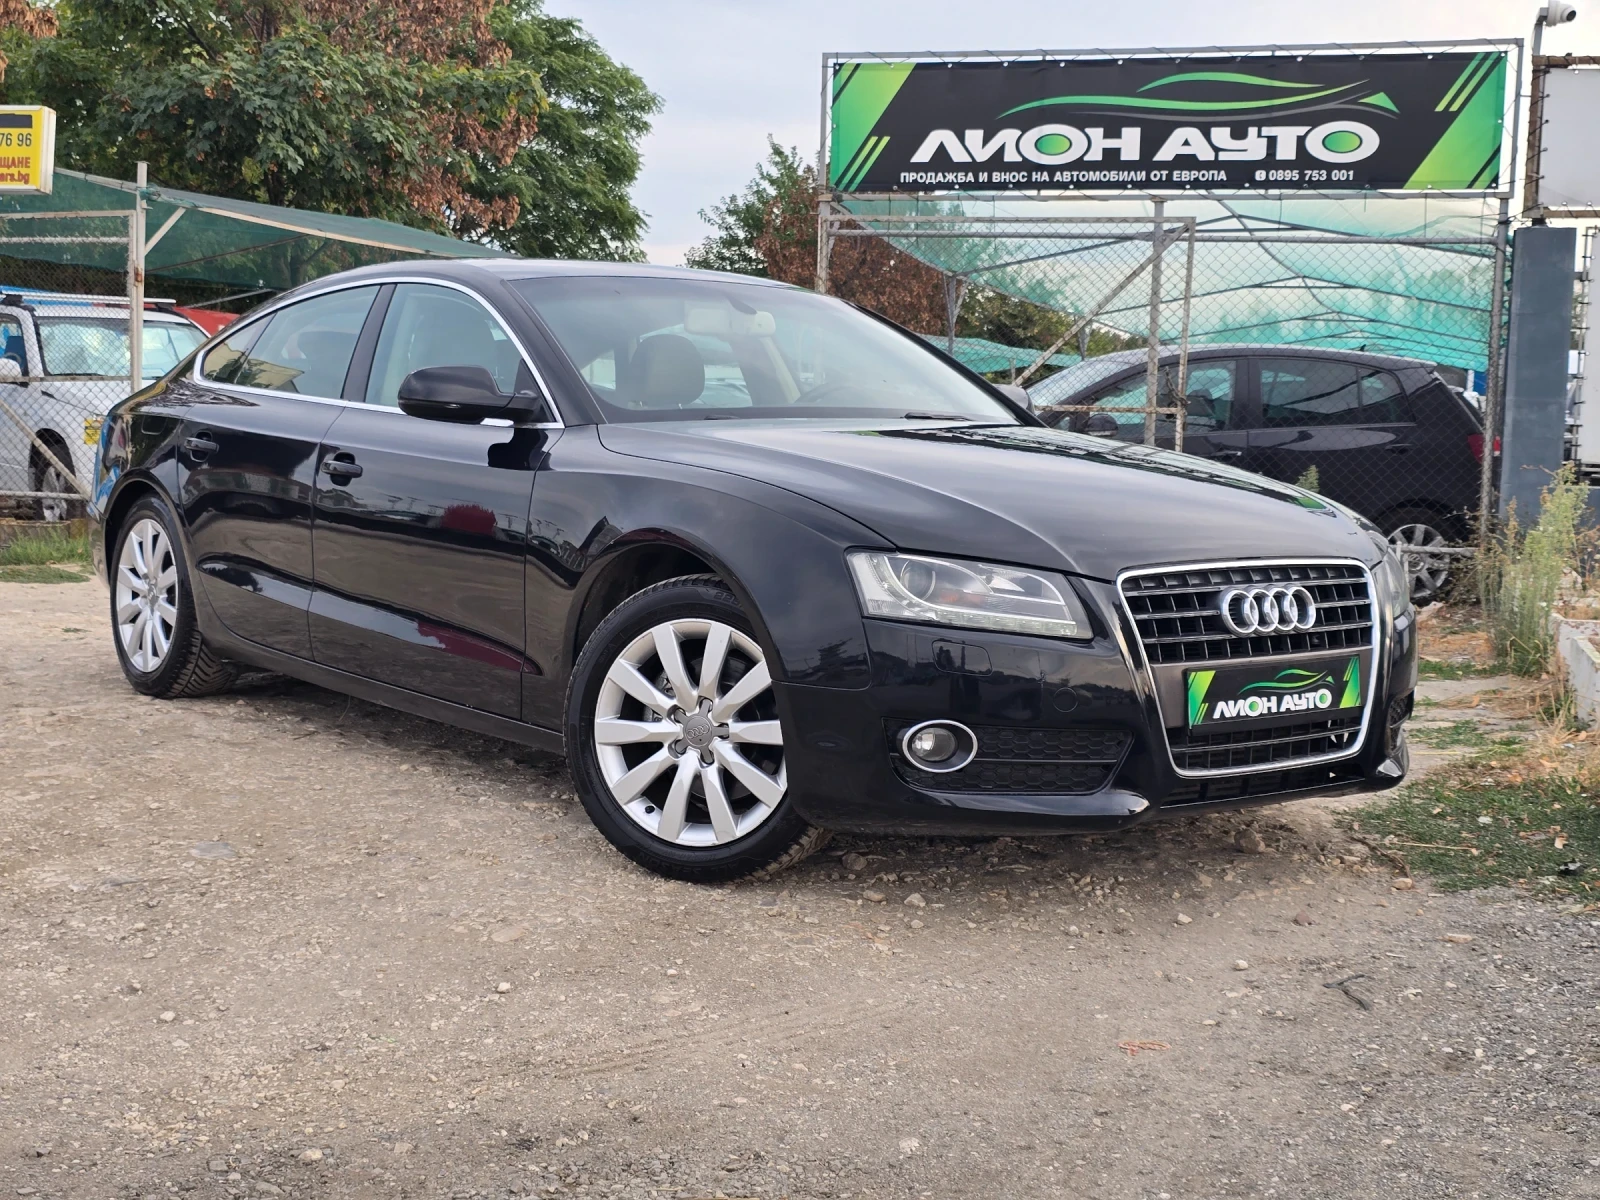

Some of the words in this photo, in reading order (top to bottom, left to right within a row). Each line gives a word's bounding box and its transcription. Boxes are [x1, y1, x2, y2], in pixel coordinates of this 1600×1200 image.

[0, 133, 12, 147] 76
[17, 133, 32, 147] 96
[910, 123, 1142, 165] ЛИОН
[1152, 120, 1381, 164] АУТО
[900, 171, 975, 184] ПРОДАЖБА
[979, 171, 988, 183] И
[992, 171, 1028, 183] ВНОС
[1032, 171, 1050, 182] НА
[1053, 170, 1146, 182] АВТОМОБИЛИ
[1150, 170, 1169, 182] ОТ
[1172, 170, 1227, 182] ЕВРОПА
[1268, 169, 1300, 181] 0895
[1304, 169, 1327, 181] 753
[1331, 169, 1354, 181] 001
[1212, 696, 1277, 719] ЛИОН
[1279, 688, 1332, 712] АУТО
